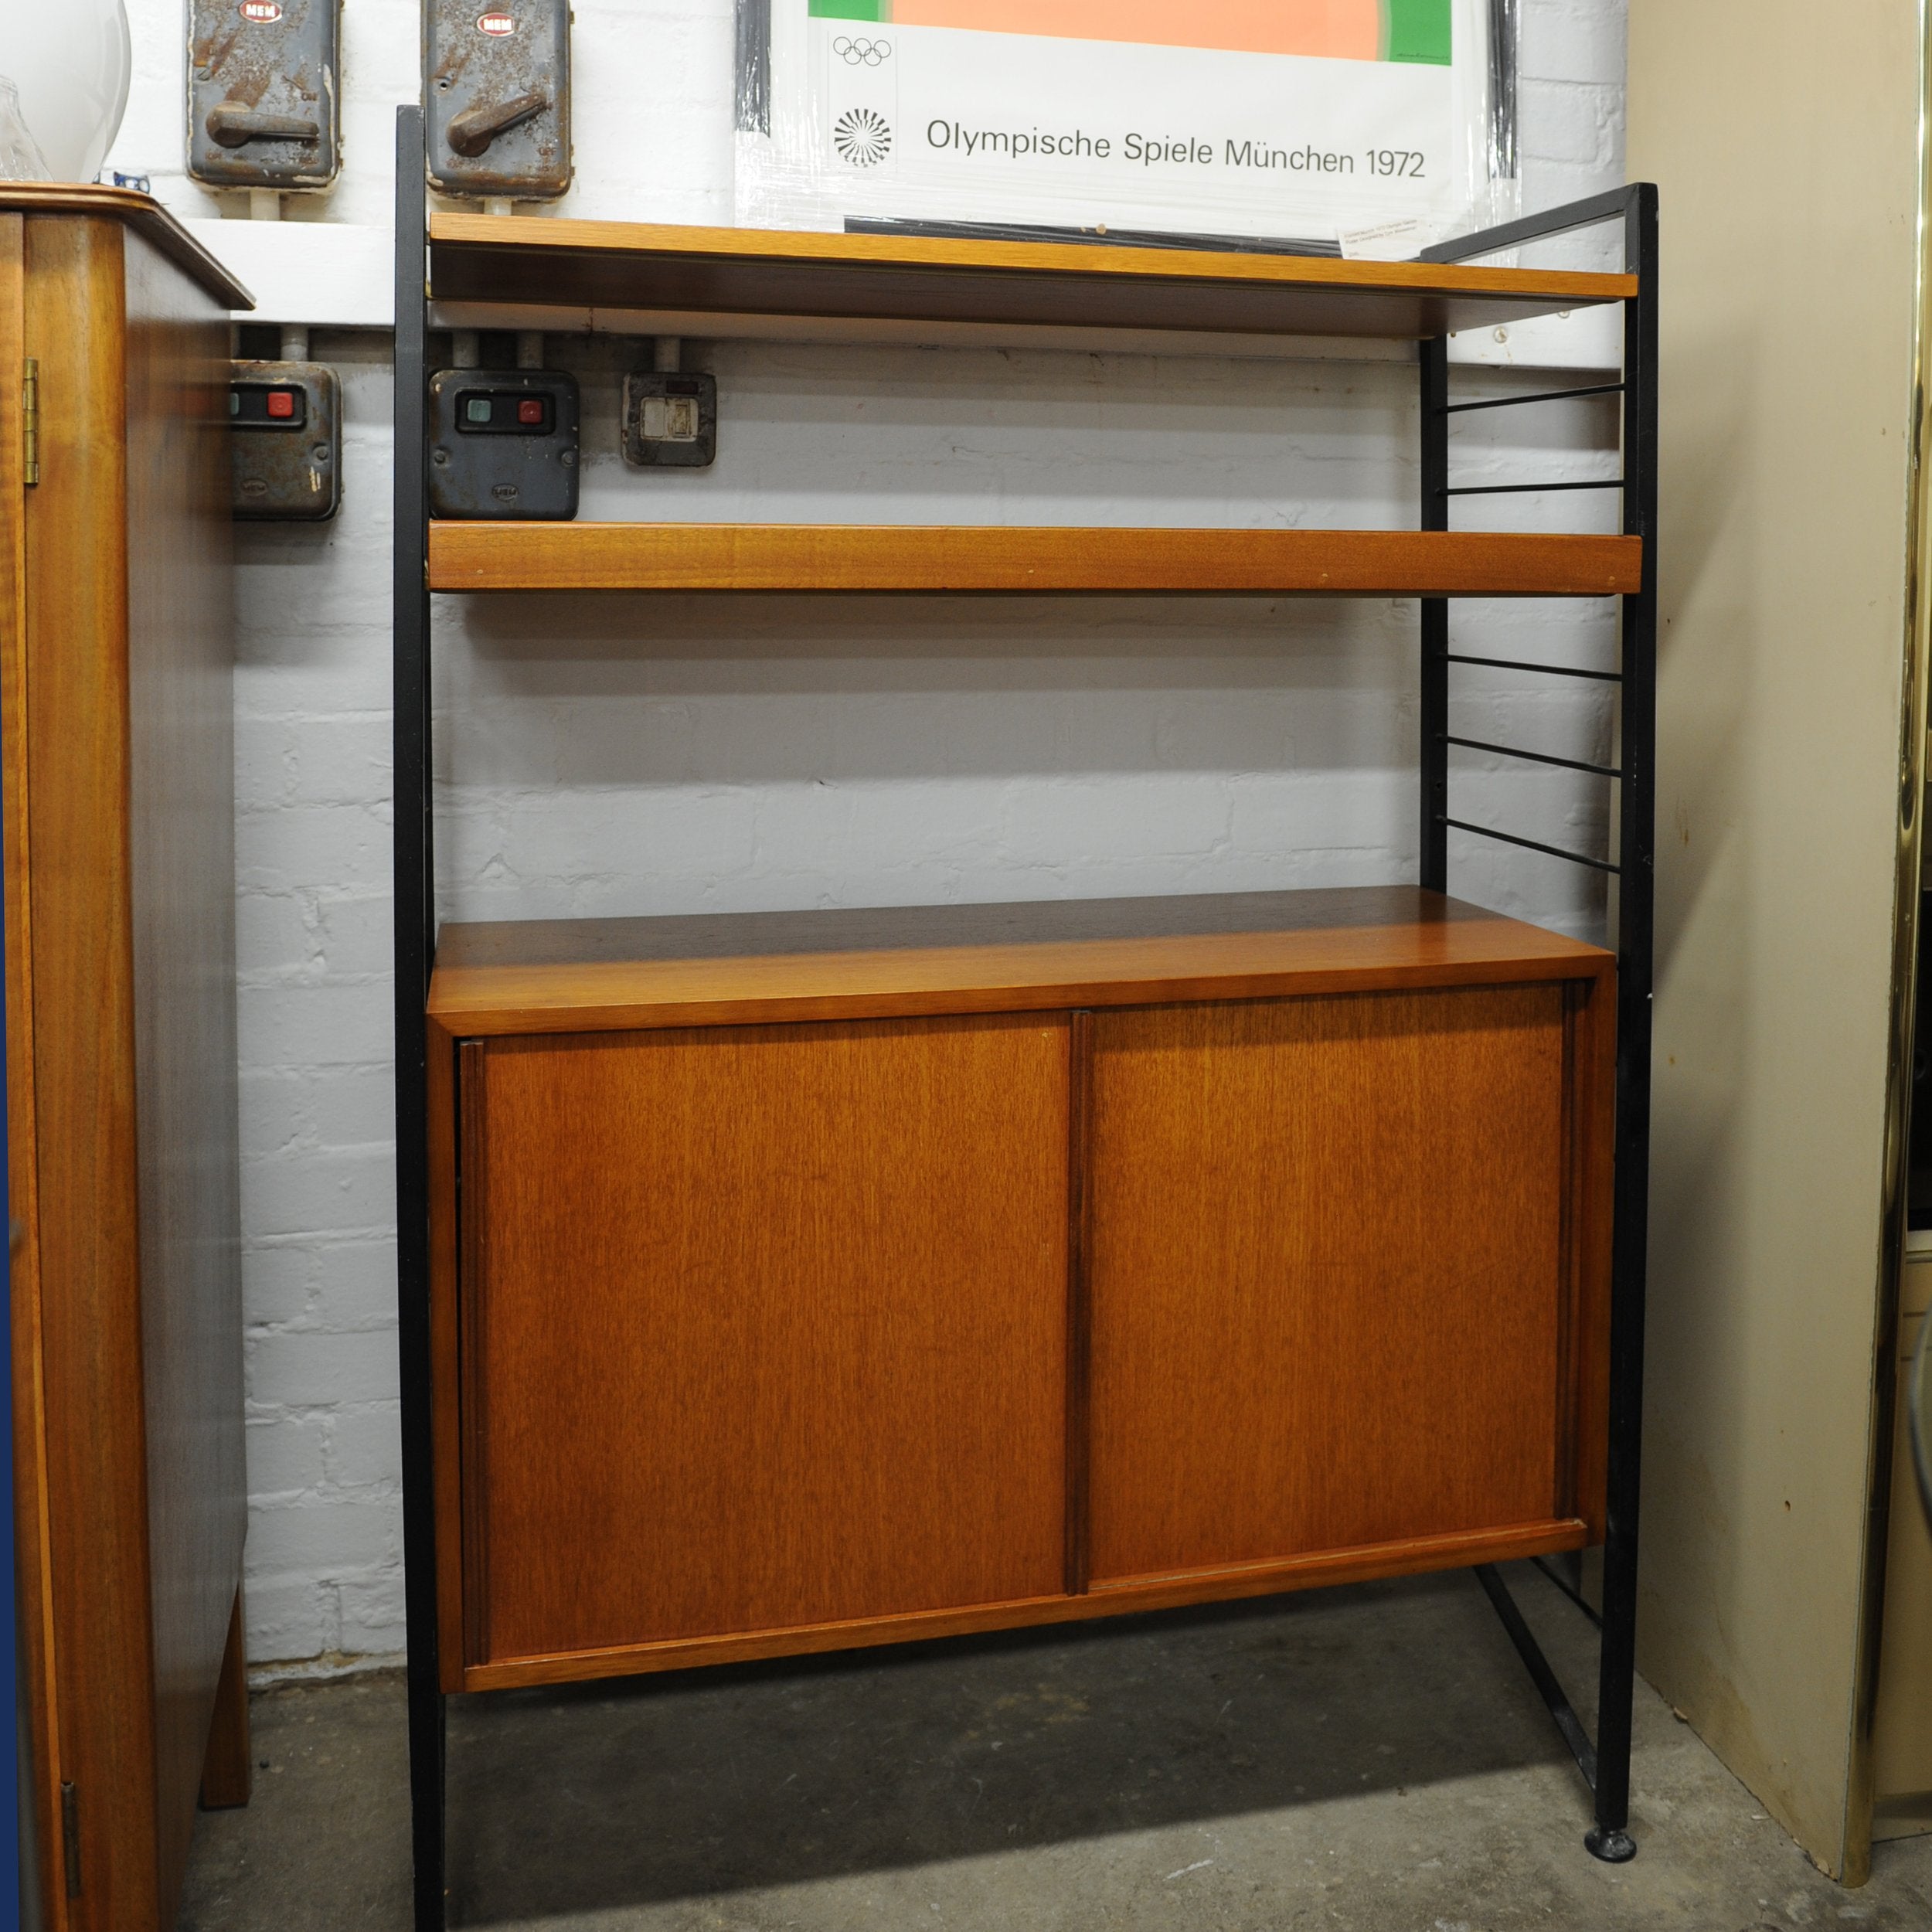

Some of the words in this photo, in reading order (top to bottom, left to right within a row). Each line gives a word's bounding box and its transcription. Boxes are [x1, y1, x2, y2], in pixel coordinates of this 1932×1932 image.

[246, 4, 276, 18] MEM
[483, 19, 512, 31] MEM
[927, 120, 1111, 158] Olympische
[1124, 133, 1213, 166] Spiele
[1226, 139, 1353, 173] München
[1367, 150, 1424, 176] 1972
